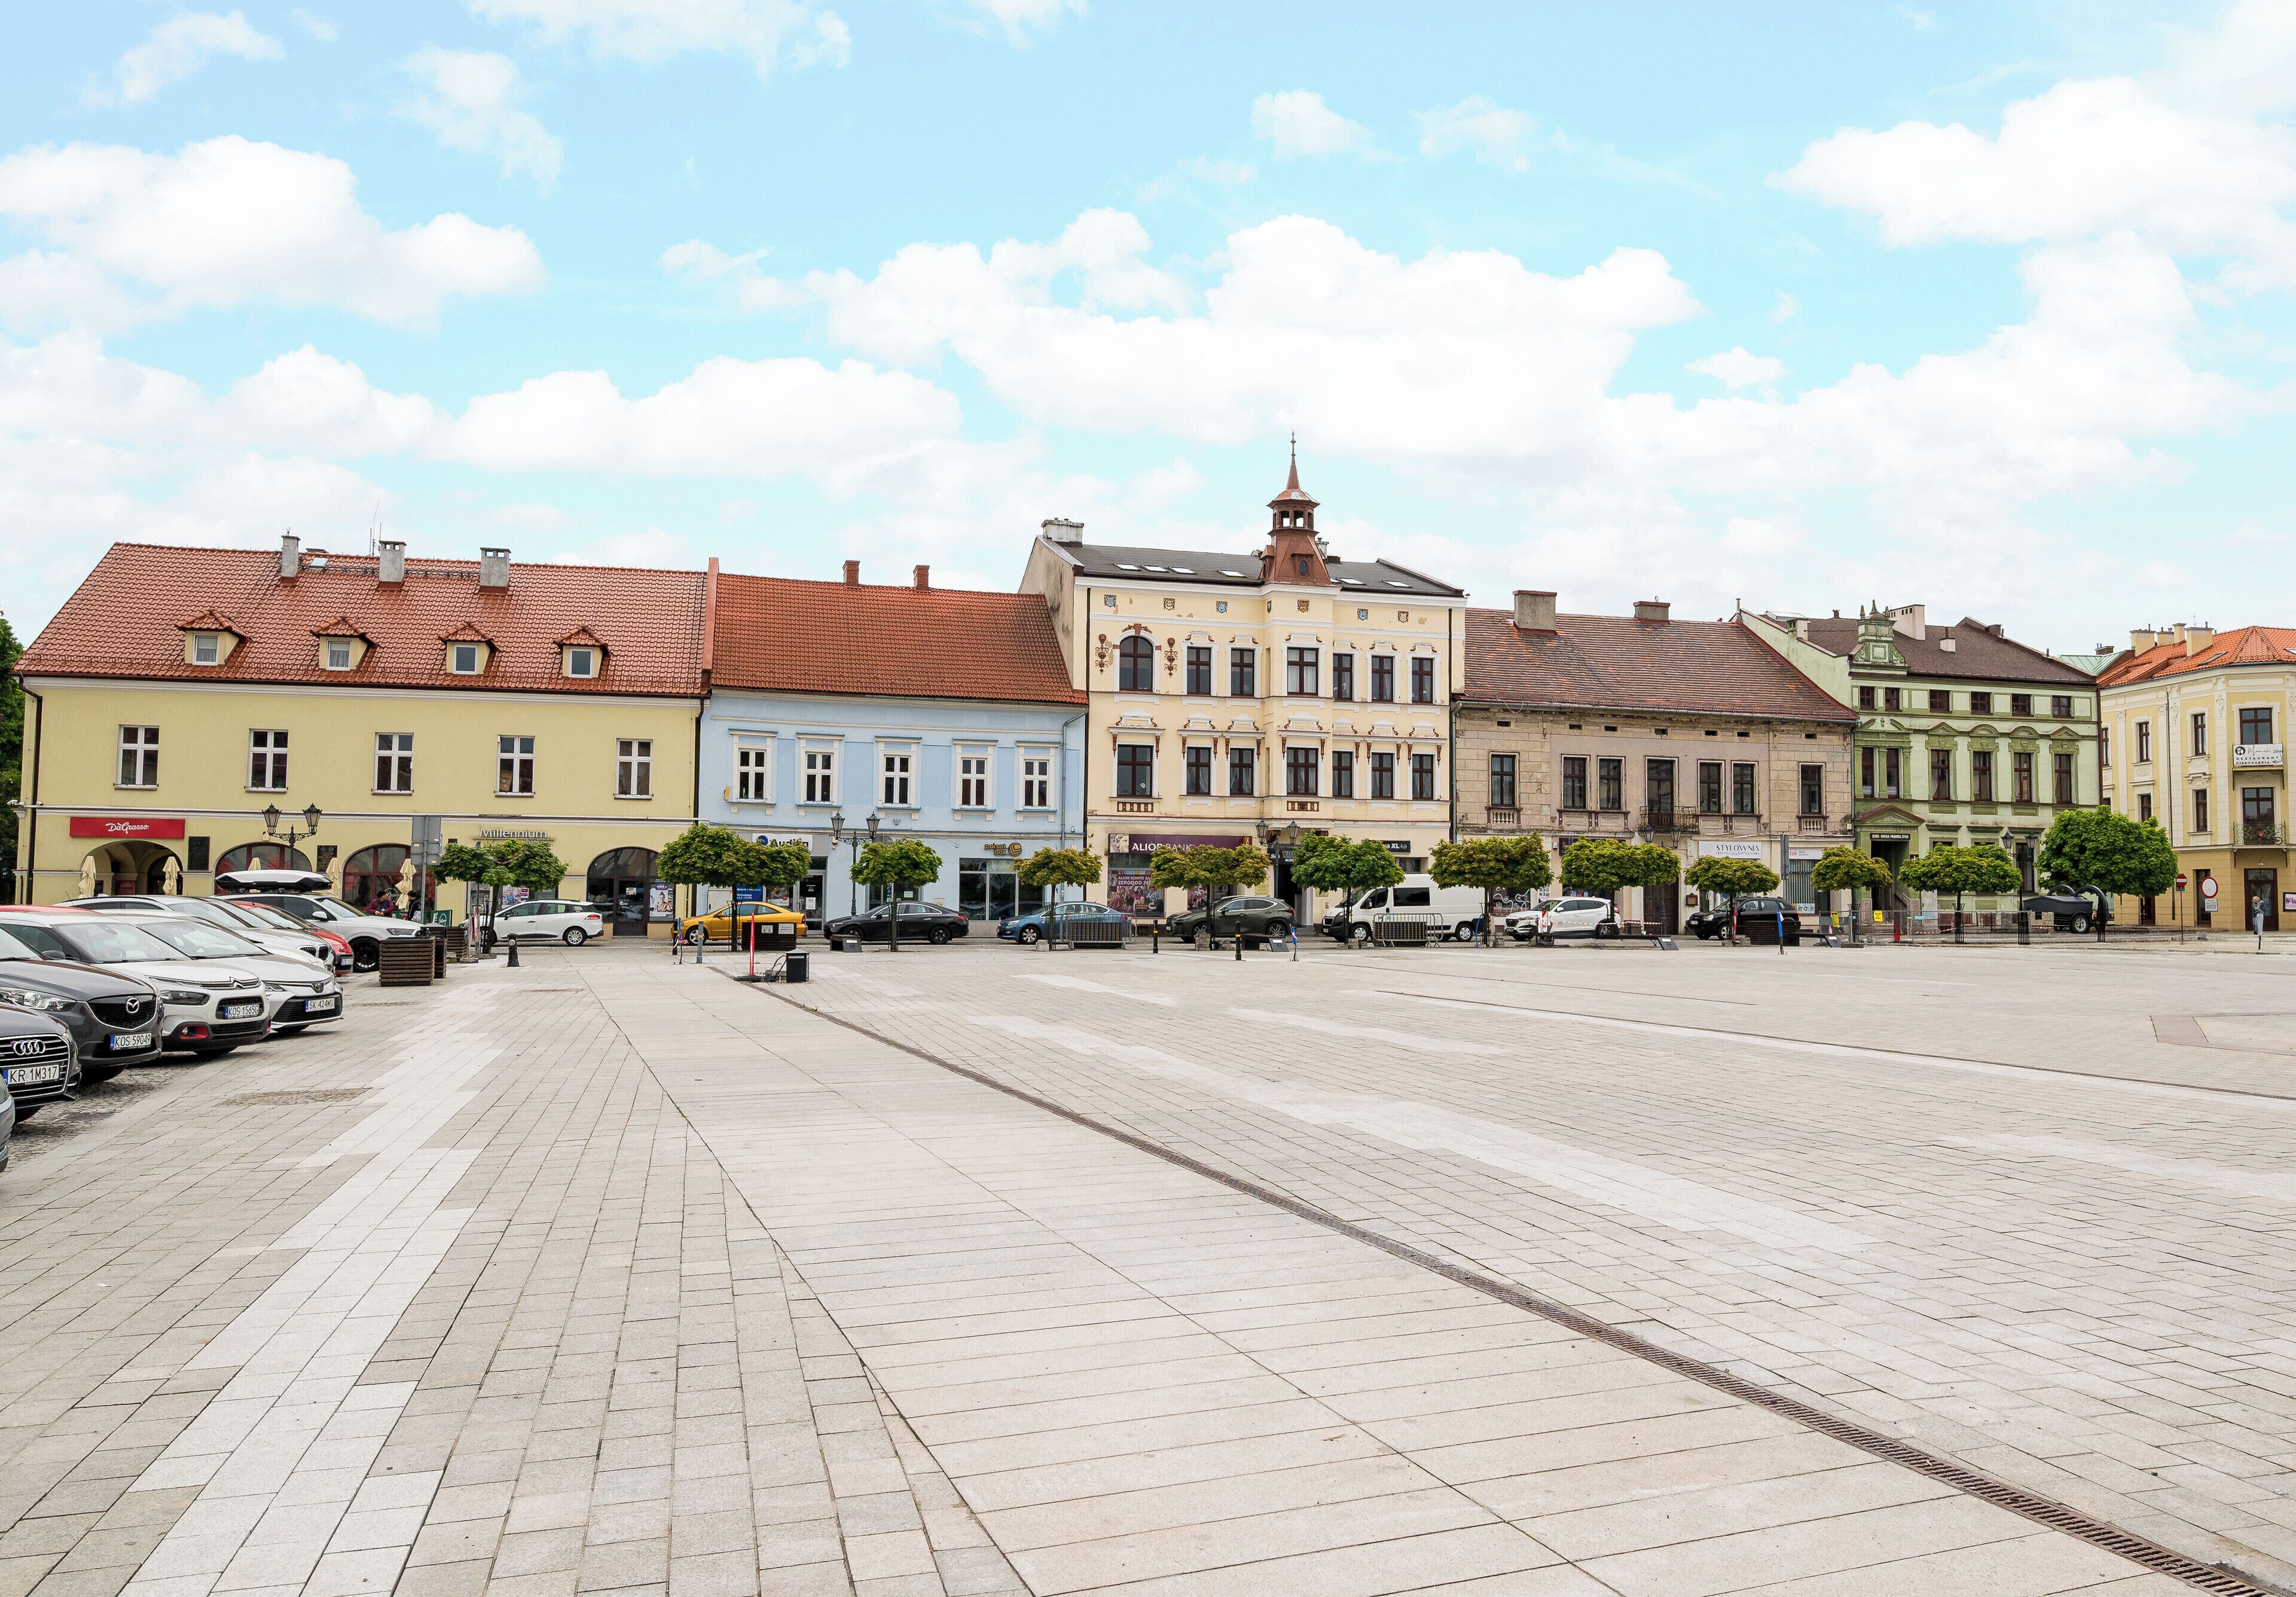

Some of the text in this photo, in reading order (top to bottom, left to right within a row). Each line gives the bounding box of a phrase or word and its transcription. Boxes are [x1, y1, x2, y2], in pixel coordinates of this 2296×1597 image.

[480, 826, 546, 838] Millennium
[310, 999, 334, 1009] SK 424WU
[228, 1005, 258, 1016] KOS 1565G
[115, 1034, 151, 1047] KOS 59049
[10, 1066, 57, 1083] KR 1M317
